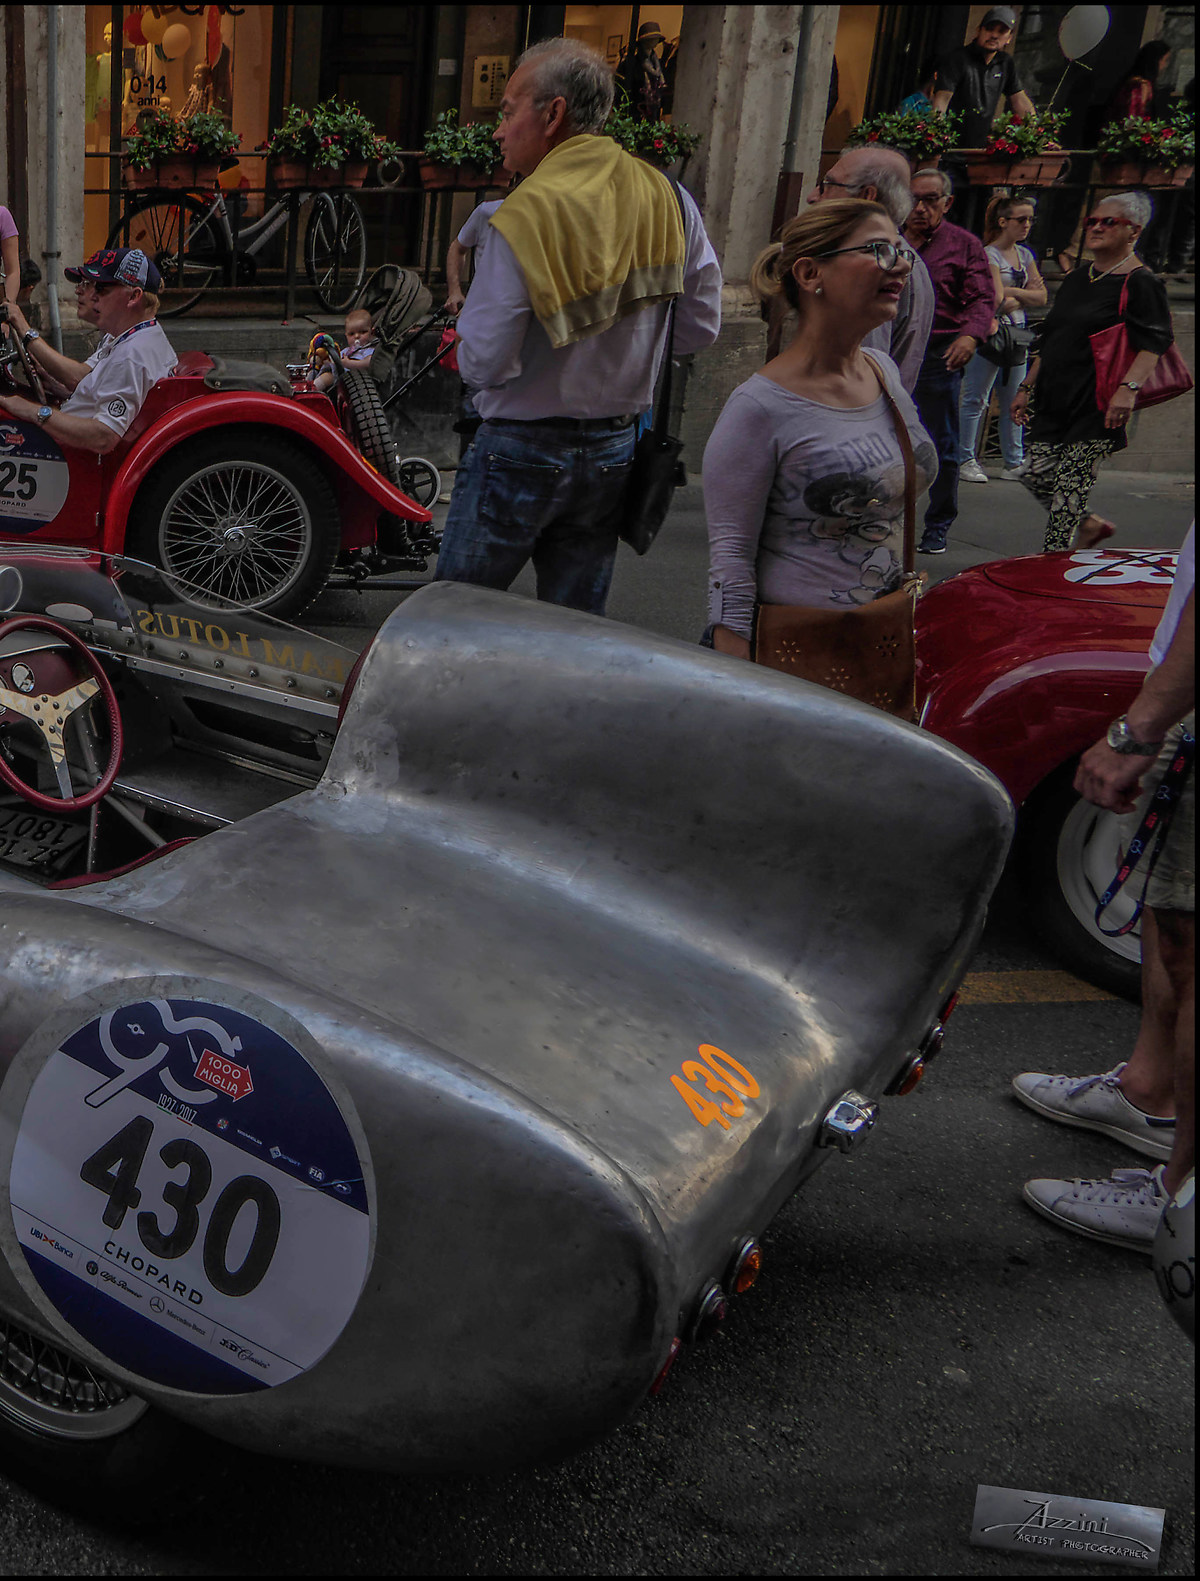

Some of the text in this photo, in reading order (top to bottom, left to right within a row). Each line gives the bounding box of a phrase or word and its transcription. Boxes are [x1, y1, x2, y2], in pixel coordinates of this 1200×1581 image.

[130, 75, 167, 94] 0-14
[137, 96, 160, 106] anni
[199, 1067, 238, 1095] MIGLIA
[208, 1056, 241, 1080] 1000
[669, 1043, 761, 1130] 430
[178, 1102, 198, 1122] 2017
[308, 1166, 324, 1182] FIA
[80, 1115, 281, 1297] 430
[30, 1227, 74, 1259] UBI Banca
[103, 1240, 203, 1305] CHOPARD
